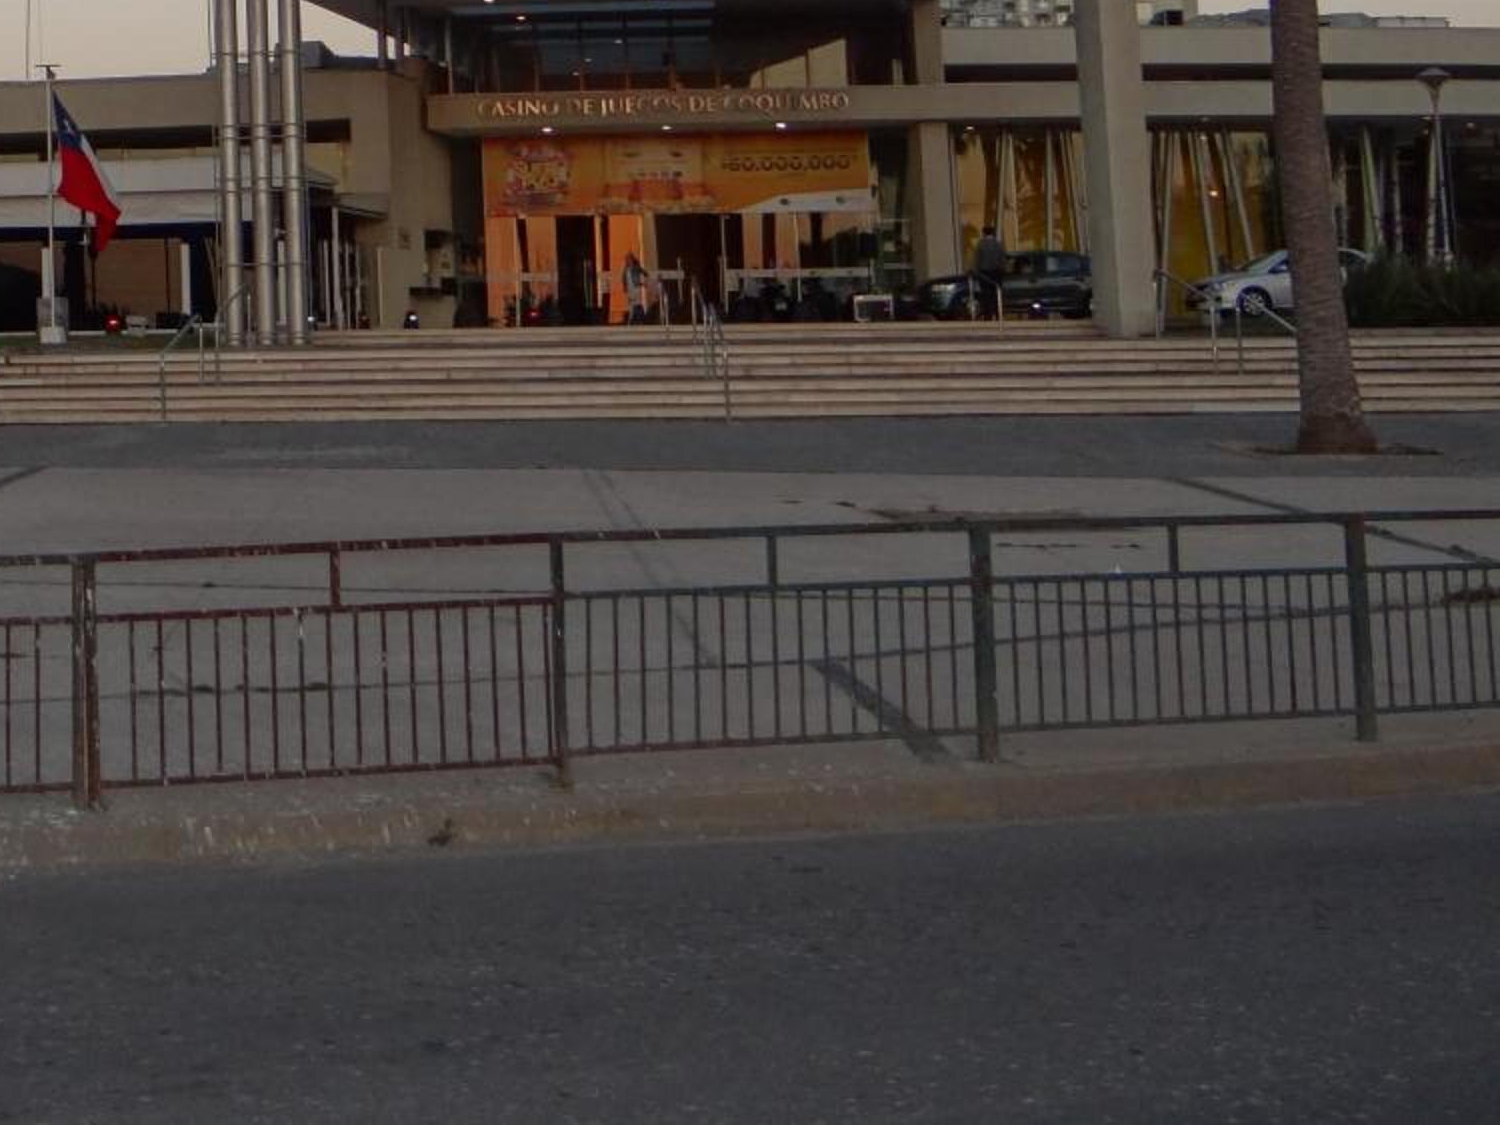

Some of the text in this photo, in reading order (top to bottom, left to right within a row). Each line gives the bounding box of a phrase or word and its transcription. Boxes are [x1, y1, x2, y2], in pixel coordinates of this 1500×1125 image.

[477, 90, 850, 117] CASINO DE JUEGOS DE COQUIMBO
